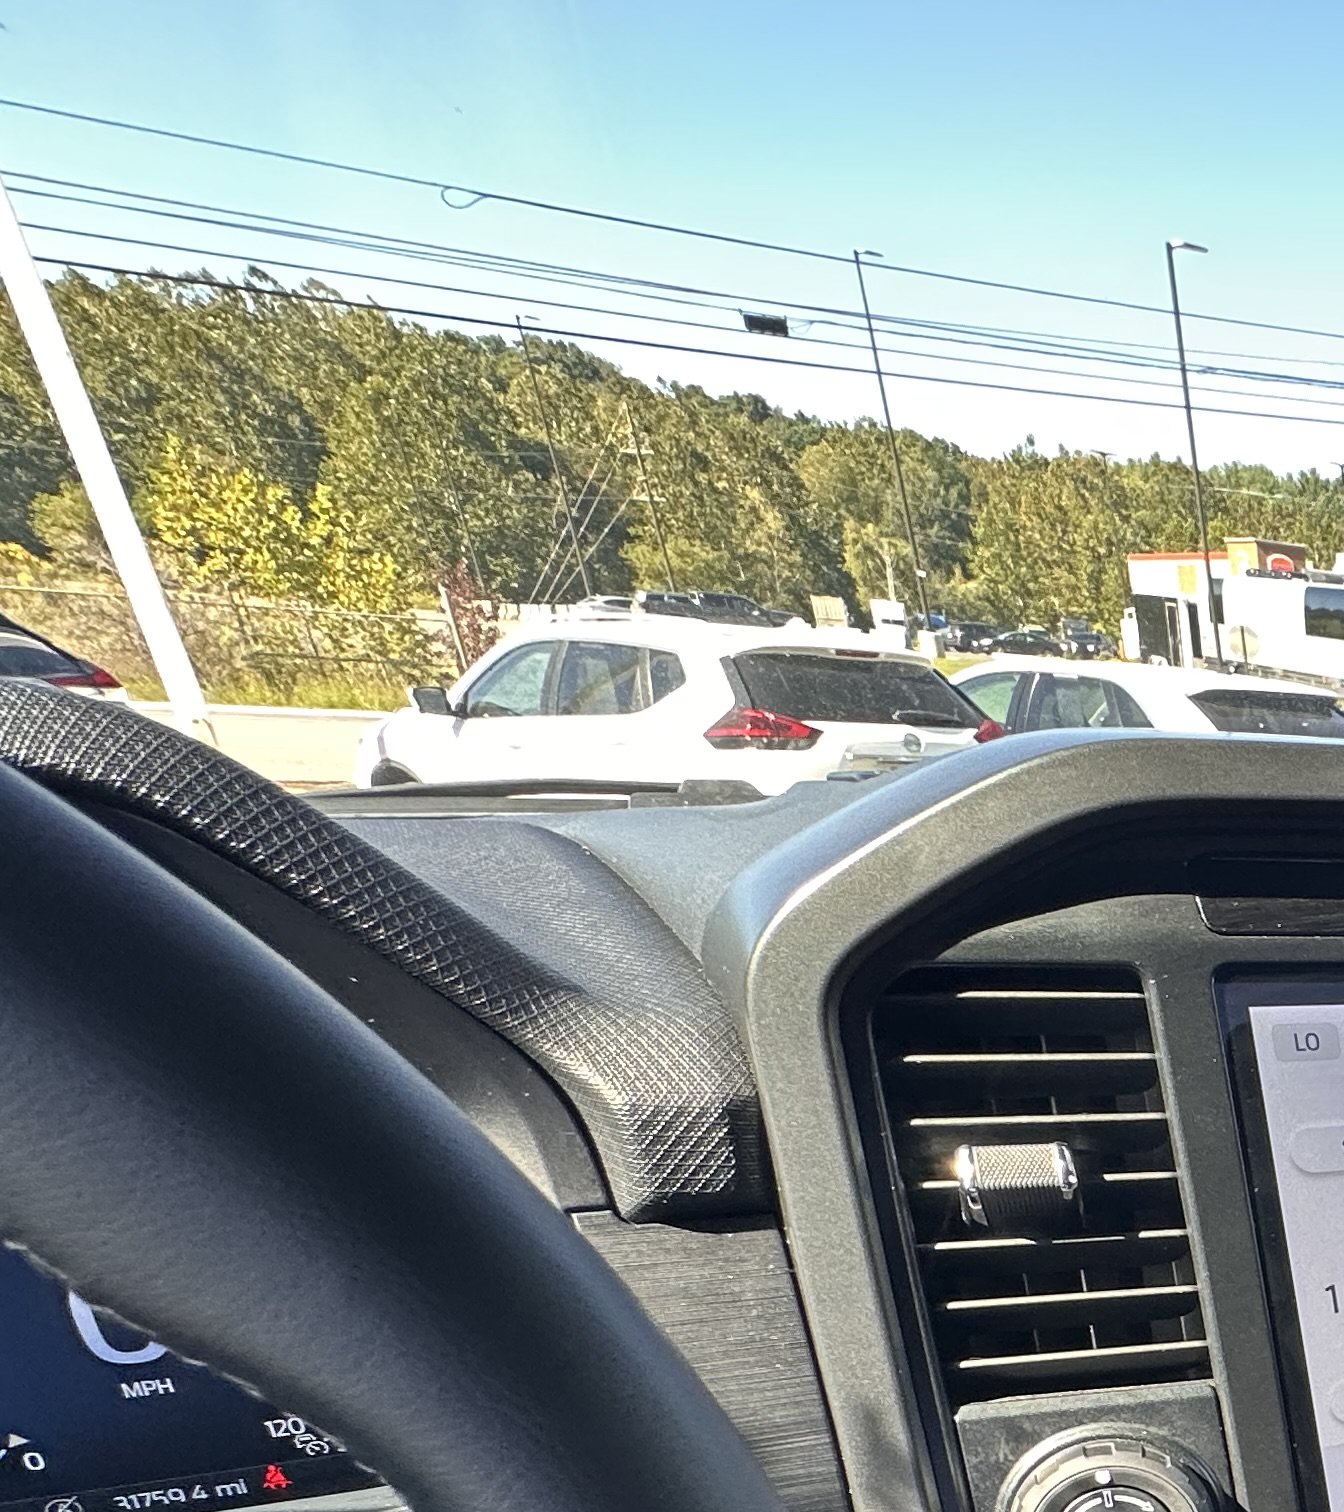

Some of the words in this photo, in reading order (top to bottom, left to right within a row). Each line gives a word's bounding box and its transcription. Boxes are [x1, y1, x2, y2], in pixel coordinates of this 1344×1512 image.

[1294, 1032, 1320, 1051] LO
[120, 1378, 175, 1399] MPH
[22, 1452, 46, 1472] 0
[215, 1478, 248, 1498] mi
